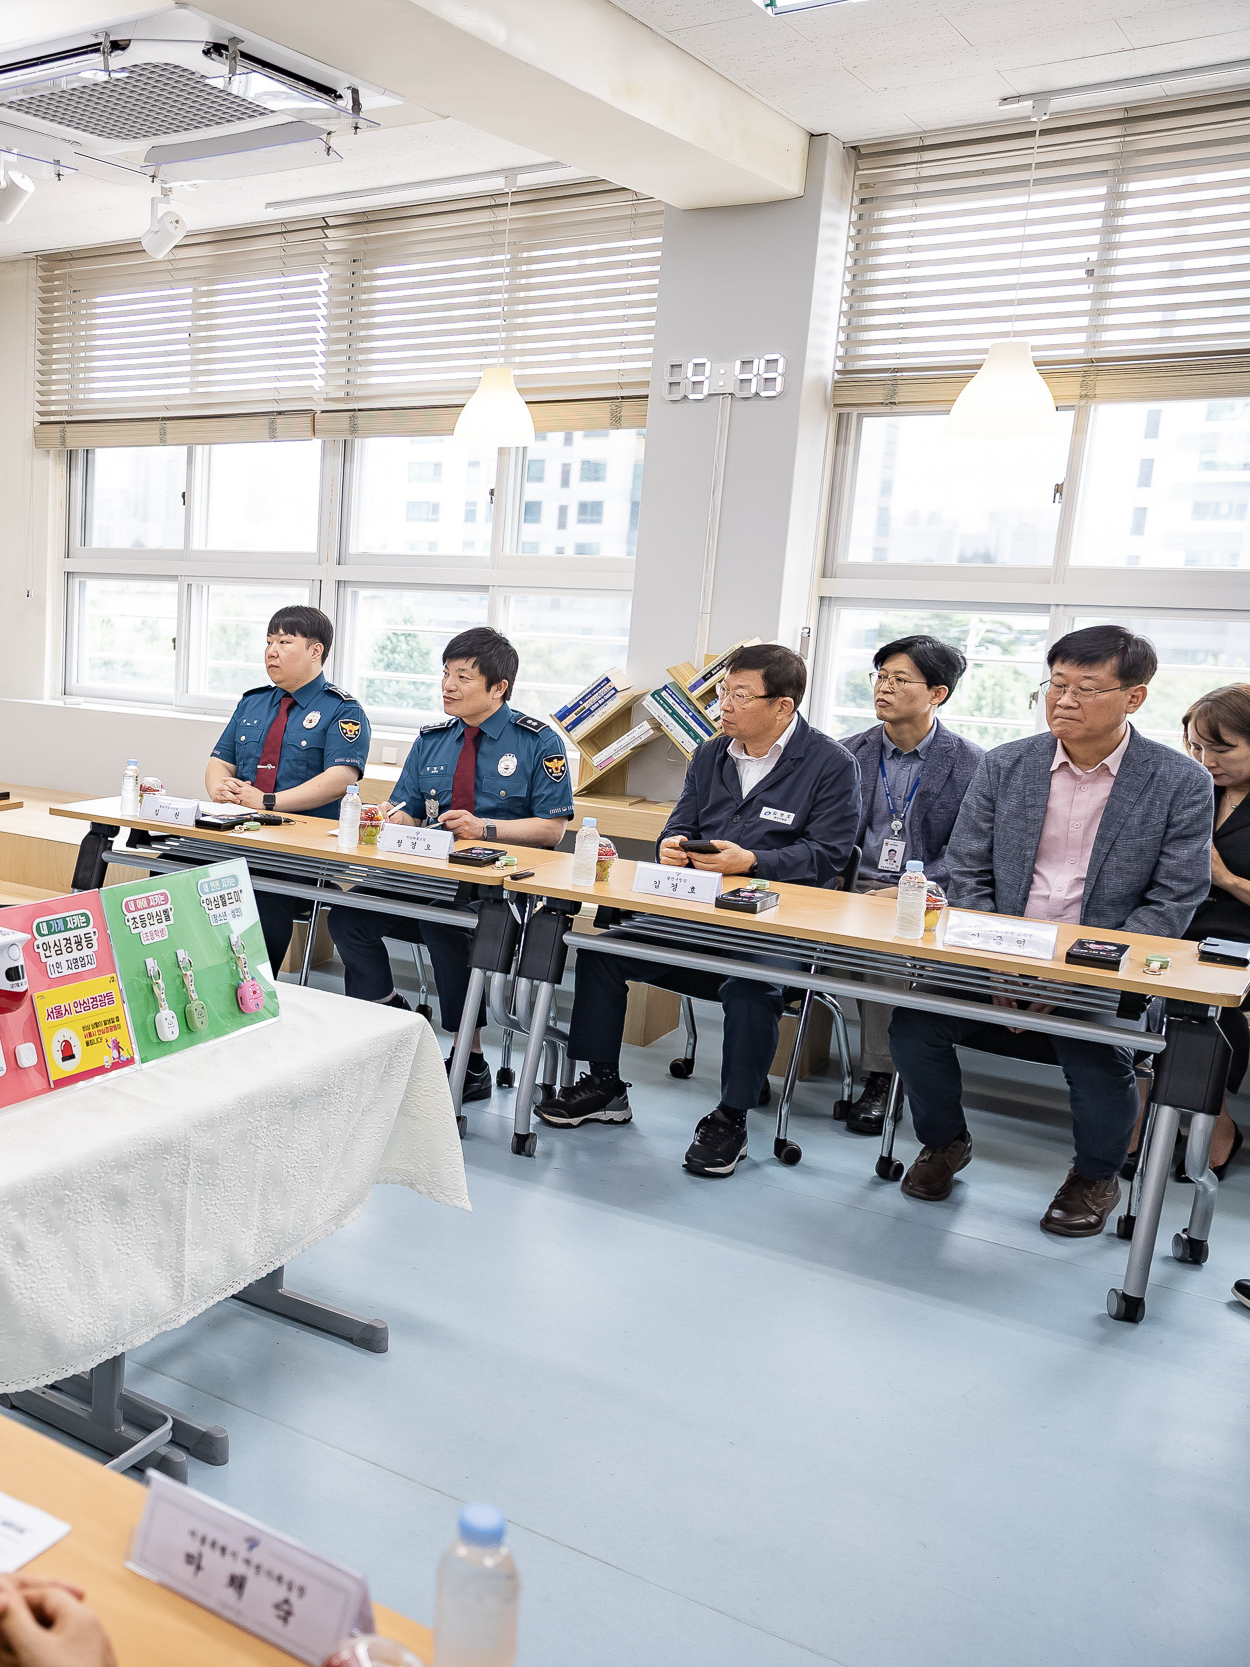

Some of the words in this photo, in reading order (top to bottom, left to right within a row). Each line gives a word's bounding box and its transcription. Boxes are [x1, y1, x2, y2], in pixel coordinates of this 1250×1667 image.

[39, 921, 49, 935] 내
[50, 918, 65, 932] 가게
[66, 914, 88, 929] 지키는
[46, 1002, 72, 1021] 서울시
[73, 991, 115, 1014] 안심경광등
